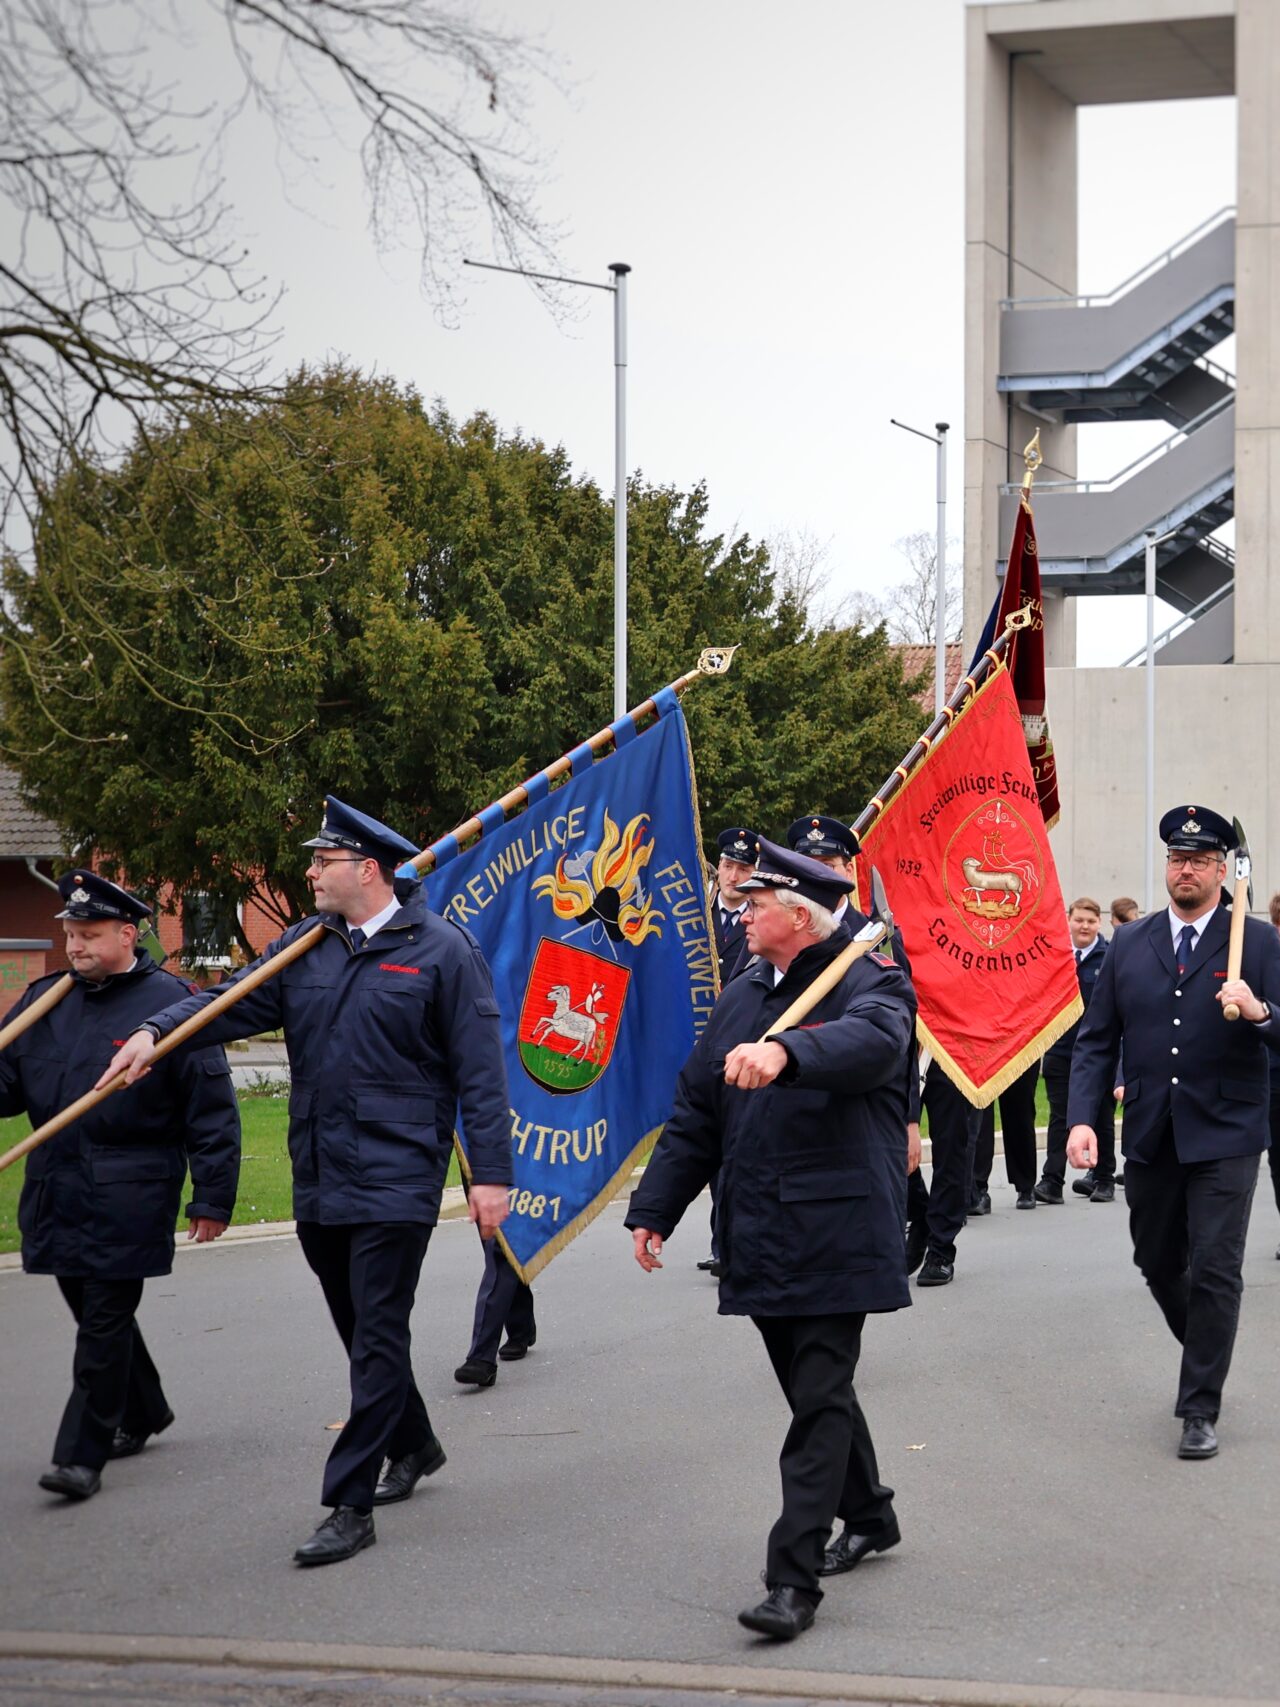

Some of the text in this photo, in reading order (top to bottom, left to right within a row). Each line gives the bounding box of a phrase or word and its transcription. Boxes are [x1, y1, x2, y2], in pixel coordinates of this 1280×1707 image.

[920, 772, 996, 834] Freiwillige
[896, 858, 922, 878] 1932
[654, 860, 719, 1046] FEUERWEH
[509, 1108, 608, 1165] HTRUP
[508, 1187, 561, 1222] 1881
